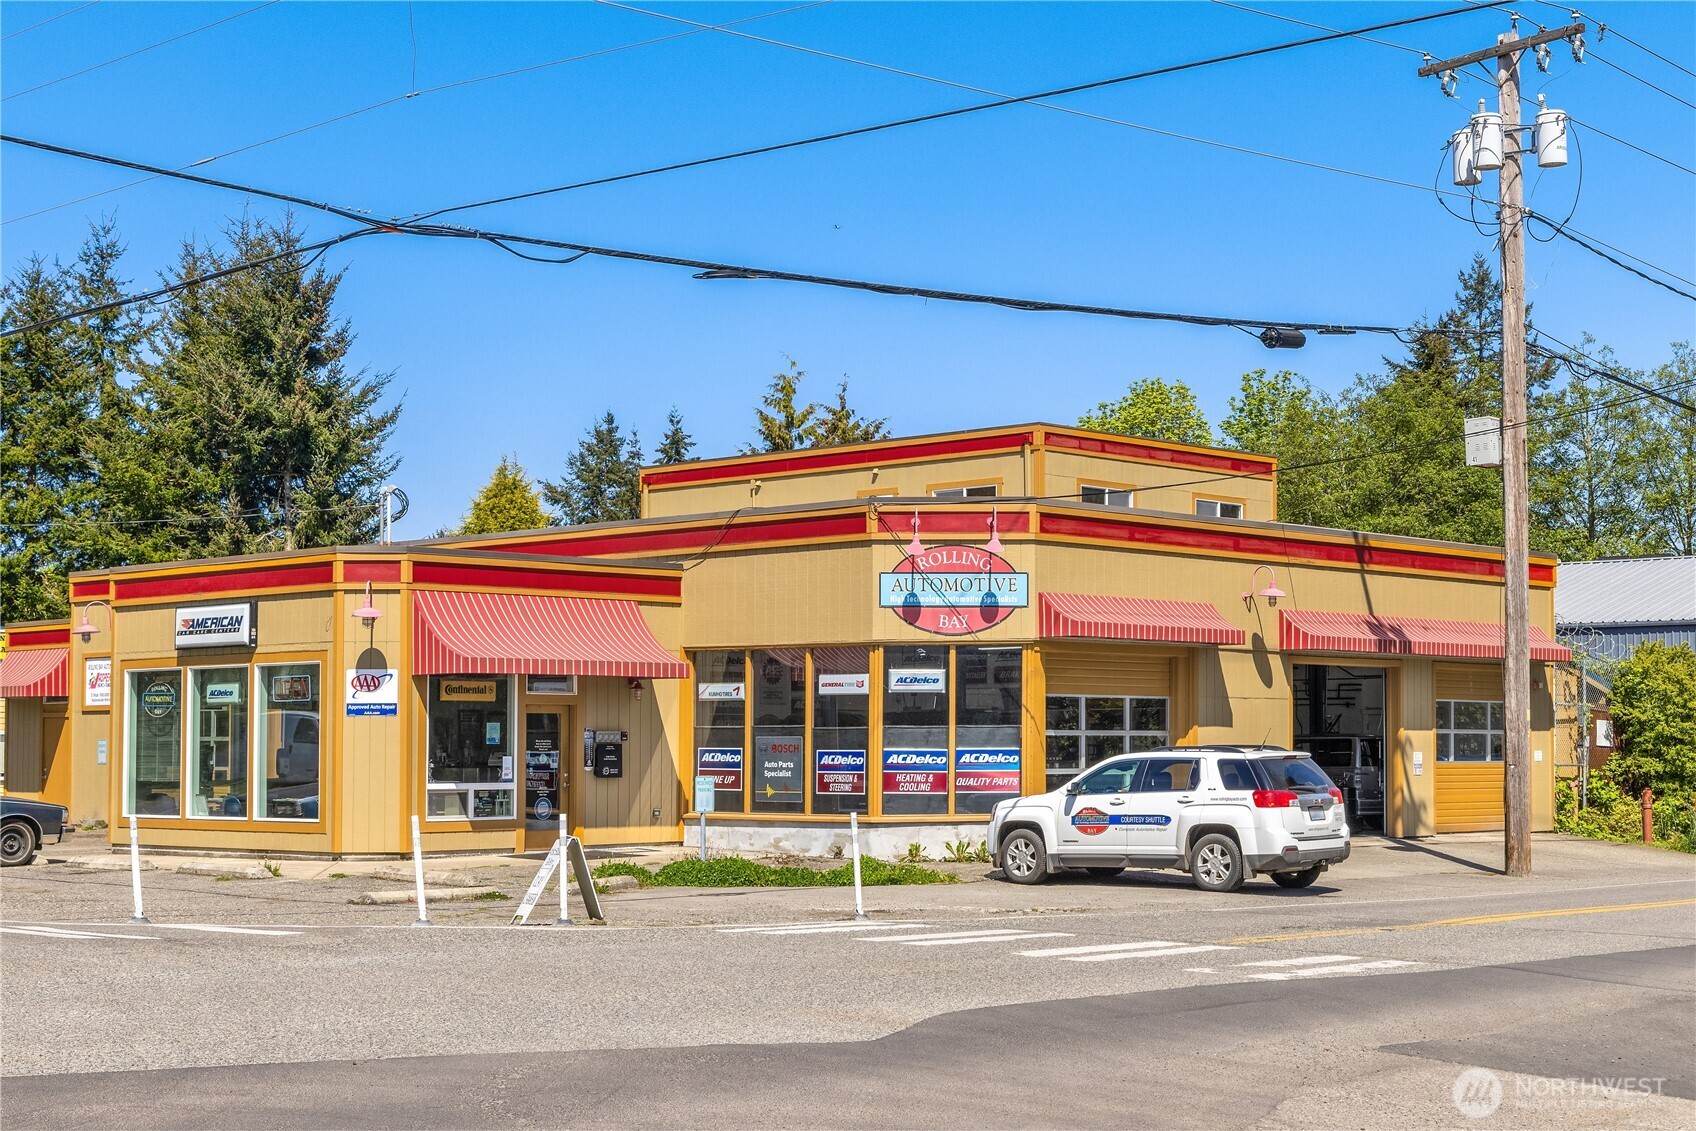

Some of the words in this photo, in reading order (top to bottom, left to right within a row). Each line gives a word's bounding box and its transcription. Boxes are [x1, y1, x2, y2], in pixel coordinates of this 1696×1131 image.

[916, 550, 992, 571] ROLLING
[891, 577, 1018, 592] AUTOMOTIVE
[187, 615, 244, 629] AMERICAN
[939, 615, 968, 628] BAY
[355, 675, 377, 692] AAA
[895, 676, 940, 684] ACDelco
[208, 689, 233, 697] ACDelco
[445, 684, 487, 696] Continental
[772, 744, 800, 753] BOSCH
[701, 753, 741, 763] ACDelco
[820, 755, 864, 765] ACDelco
[886, 754, 947, 764] ACDelco
[959, 753, 1019, 763] ACDelco
[764, 770, 792, 778] Specialist
[823, 774, 852, 782] SUSPENSION
[896, 773, 926, 782] HEATING
[927, 774, 933, 782] &
[713, 776, 724, 784] NE
[724, 775, 735, 784] UP
[956, 777, 991, 786] QUALITY
[992, 777, 1019, 786] PARTS
[829, 783, 852, 792] STEERING
[899, 783, 931, 791] COOLING
